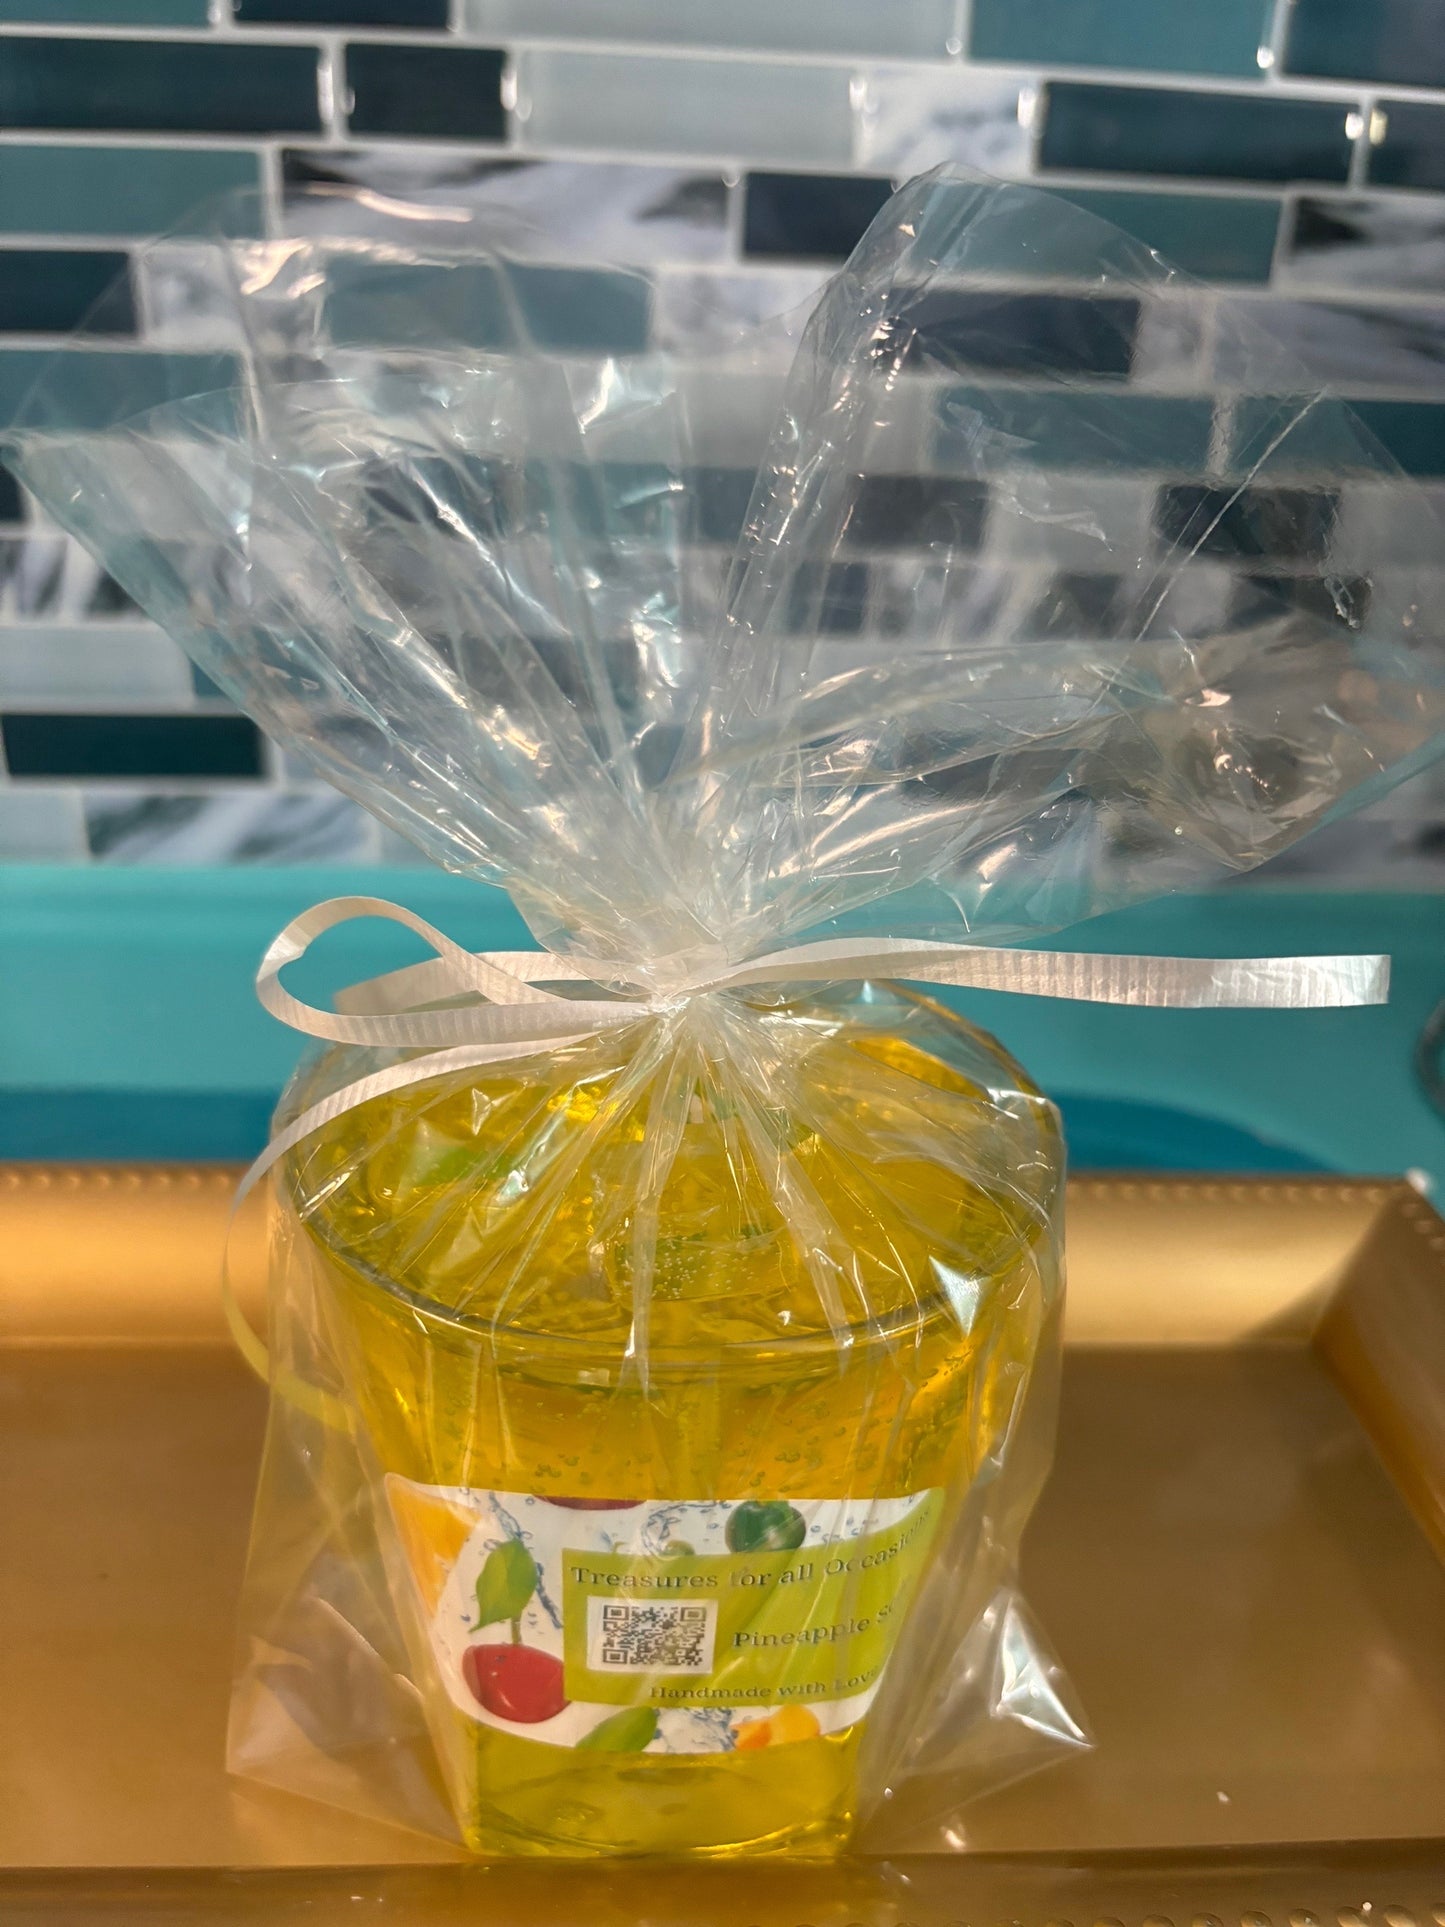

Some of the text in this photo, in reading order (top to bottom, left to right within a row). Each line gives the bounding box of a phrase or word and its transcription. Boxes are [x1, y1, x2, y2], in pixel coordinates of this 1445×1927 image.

[570, 1566, 719, 1588] Treasures
[778, 1562, 814, 1586] all
[733, 1617, 870, 1648] Pineapple
[650, 1685, 771, 1699] Handmade
[777, 1681, 827, 1697] with
